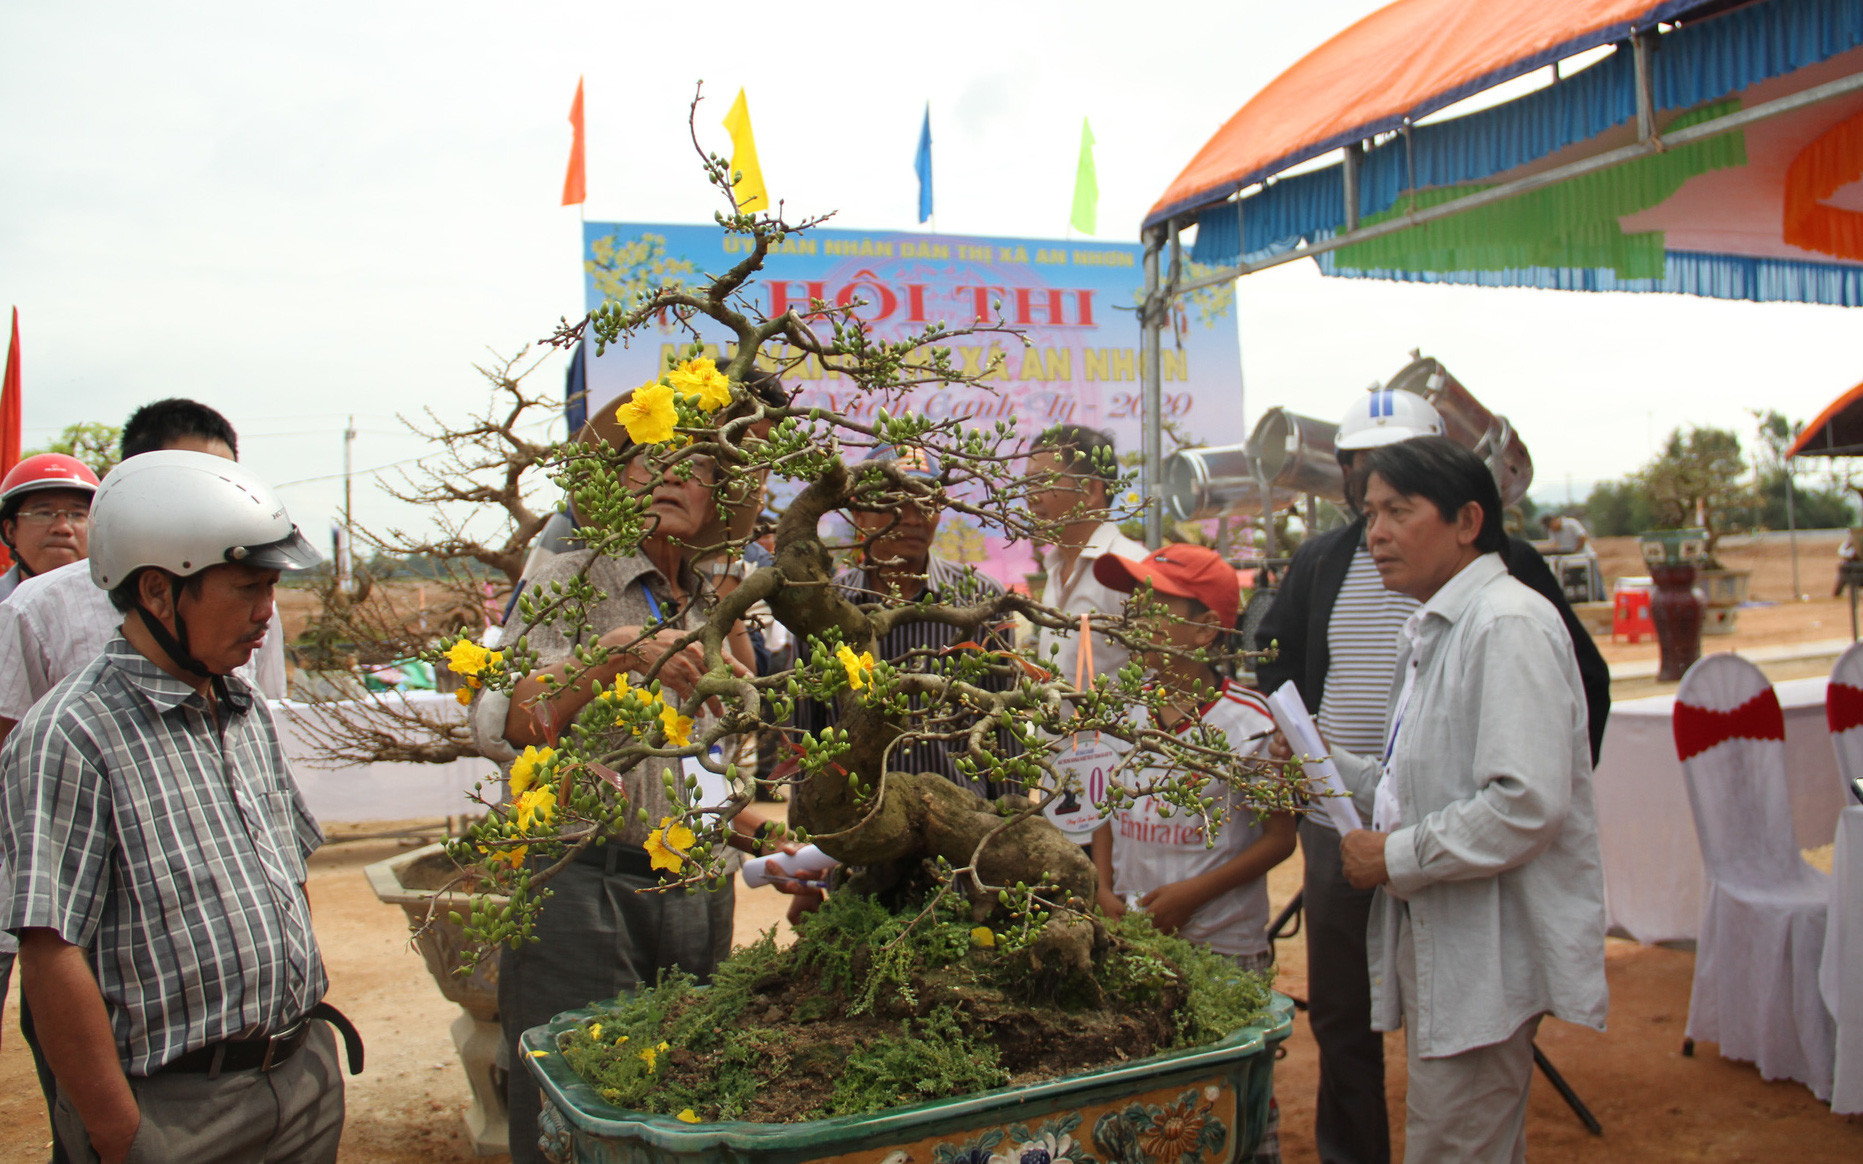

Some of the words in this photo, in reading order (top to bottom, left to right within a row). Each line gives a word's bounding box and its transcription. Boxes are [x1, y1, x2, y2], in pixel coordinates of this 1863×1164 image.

[765, 236, 818, 256] BAN
[824, 237, 894, 258] NHÂN
[901, 240, 949, 260] DÂN
[957, 245, 992, 266] THỊ
[1000, 245, 1029, 263] XÃ
[1035, 248, 1067, 265] AN
[1073, 249, 1134, 268] NHƠN
[762, 269, 932, 333] HỘI
[955, 285, 1099, 327] THI
[957, 340, 1010, 382] XÃ
[1020, 347, 1072, 382] AN
[924, 392, 1015, 418] Canh
[1120, 812, 1204, 845] Emirates
